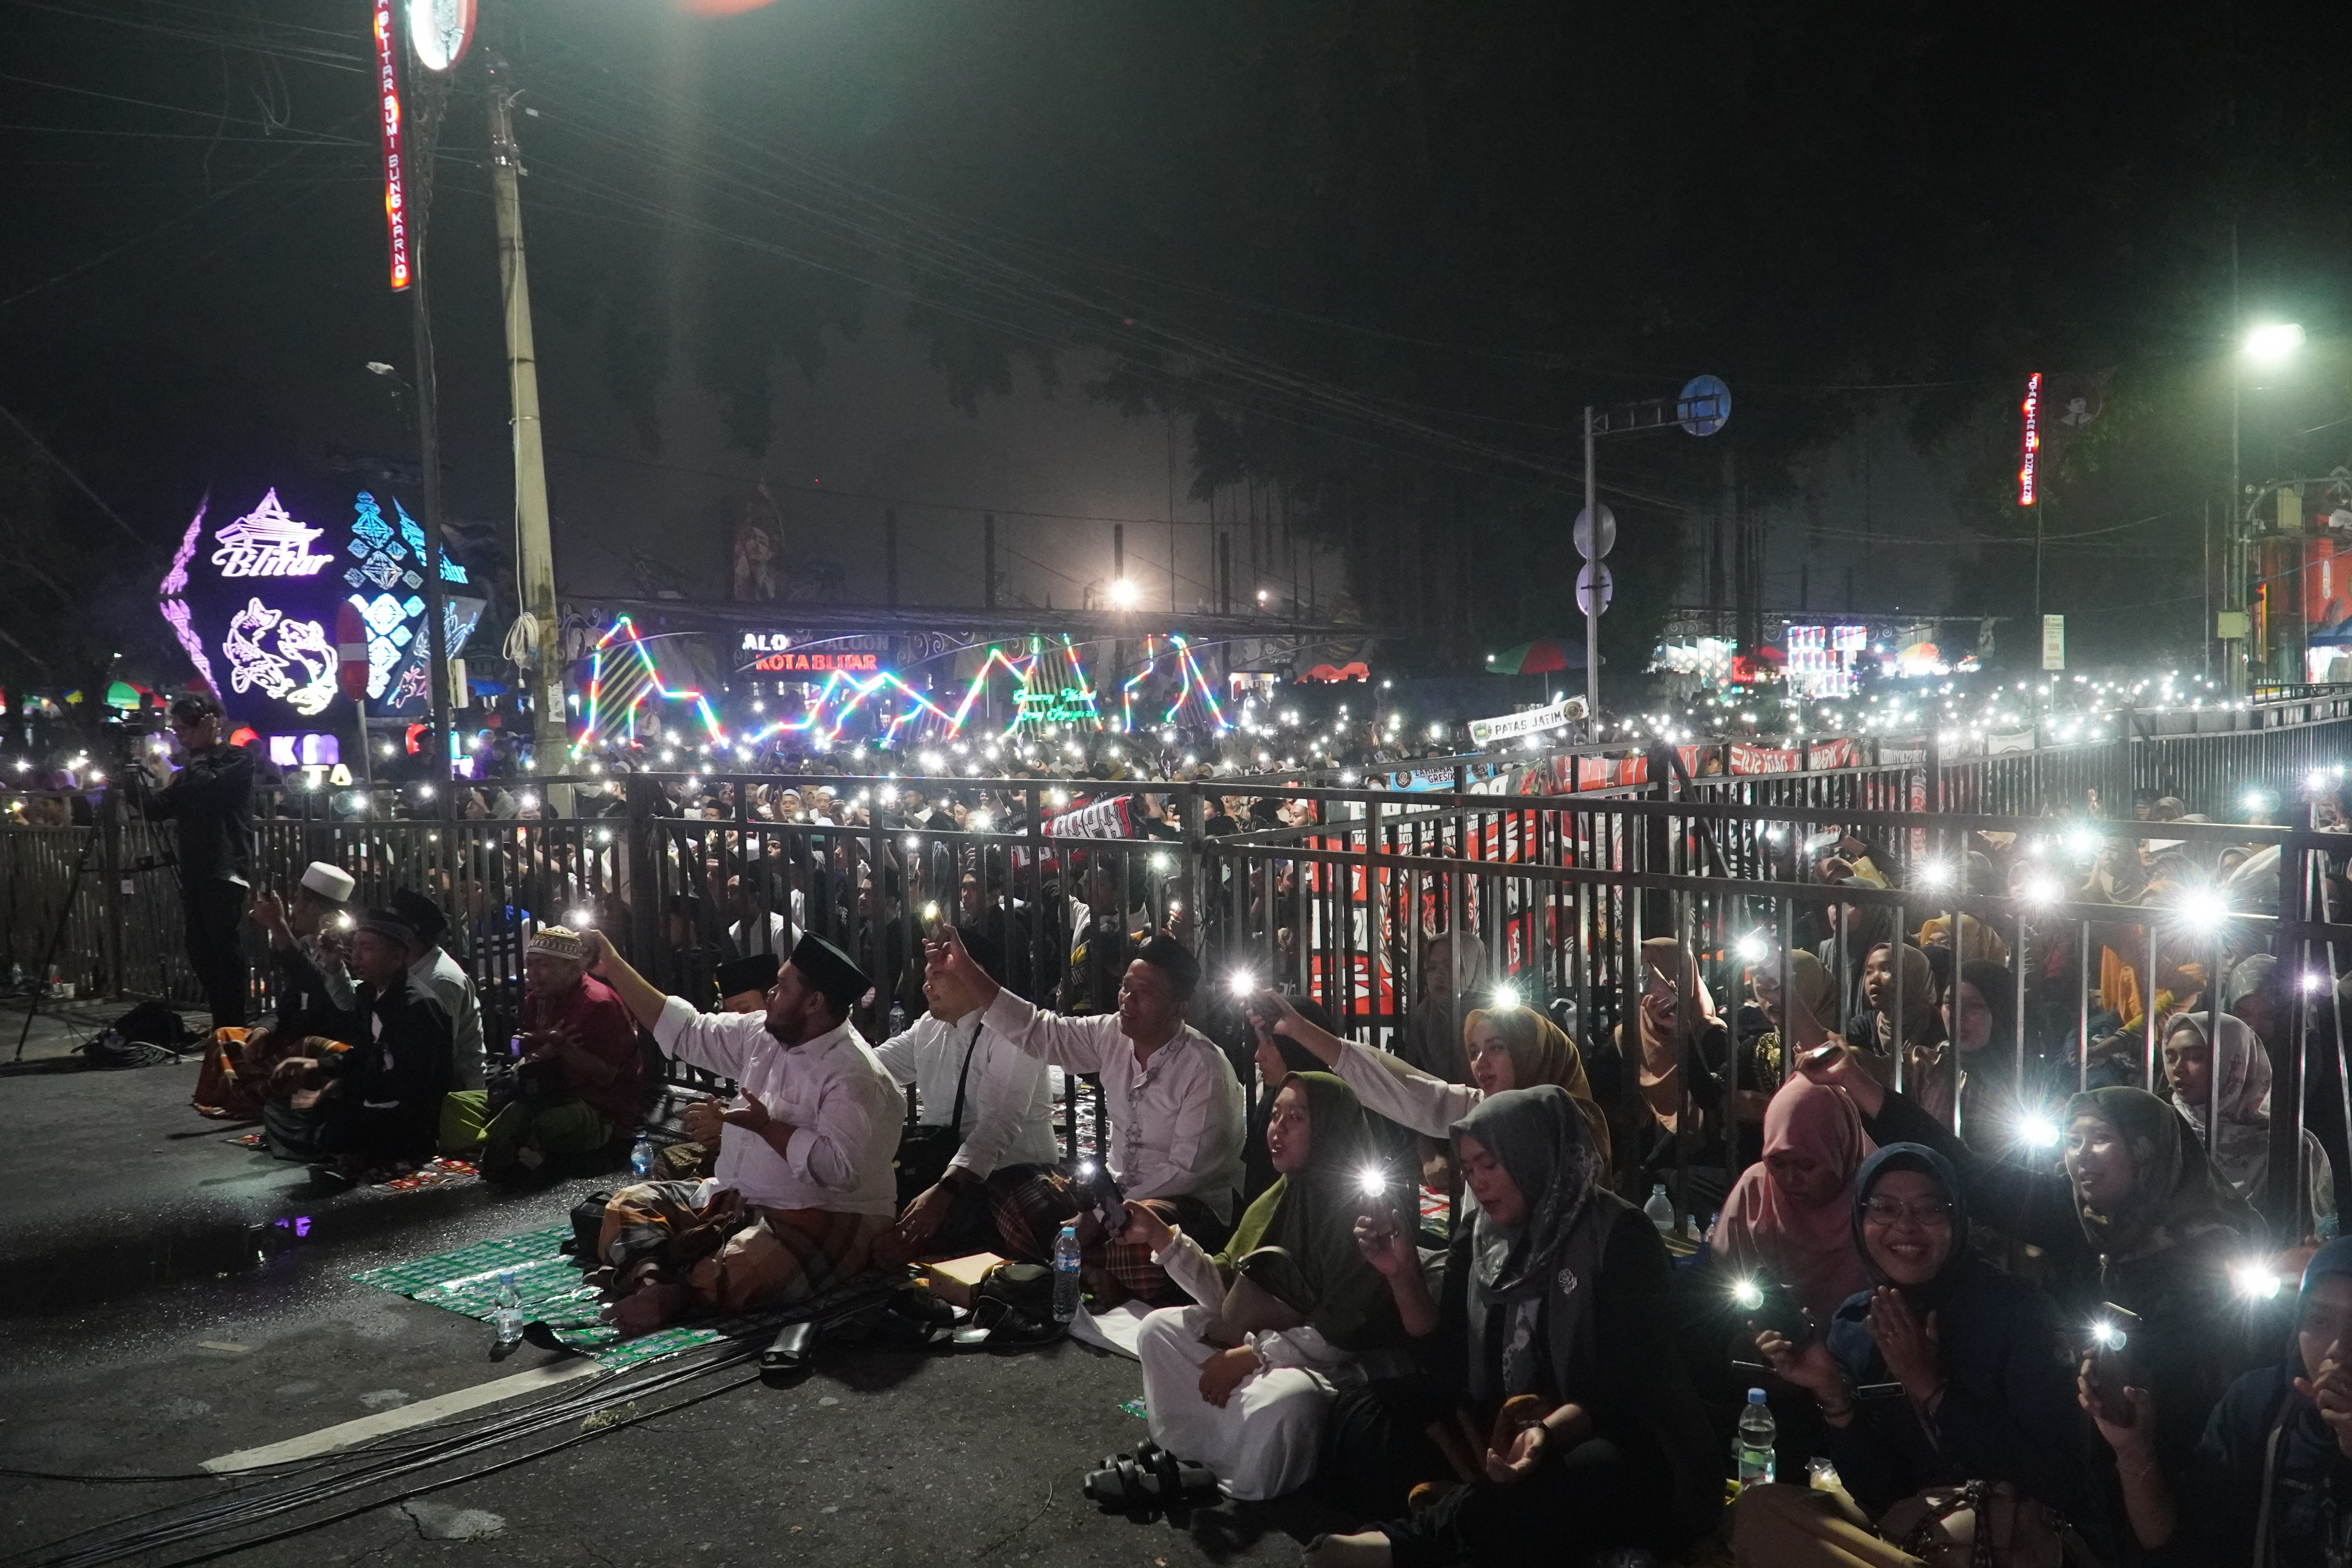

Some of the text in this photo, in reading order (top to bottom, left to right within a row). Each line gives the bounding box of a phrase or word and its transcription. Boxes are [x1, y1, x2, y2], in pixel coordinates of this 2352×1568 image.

[377, 10, 394, 93] BLITAR
[384, 95, 397, 149] BUMI
[388, 154, 402, 208] BUNG
[392, 211, 407, 279] KARNO
[211, 547, 334, 577] Blitar
[755, 654, 878, 670] KOTA BLITAR
[1495, 720, 1527, 735] PATAS
[1532, 711, 1562, 727] JATIM
